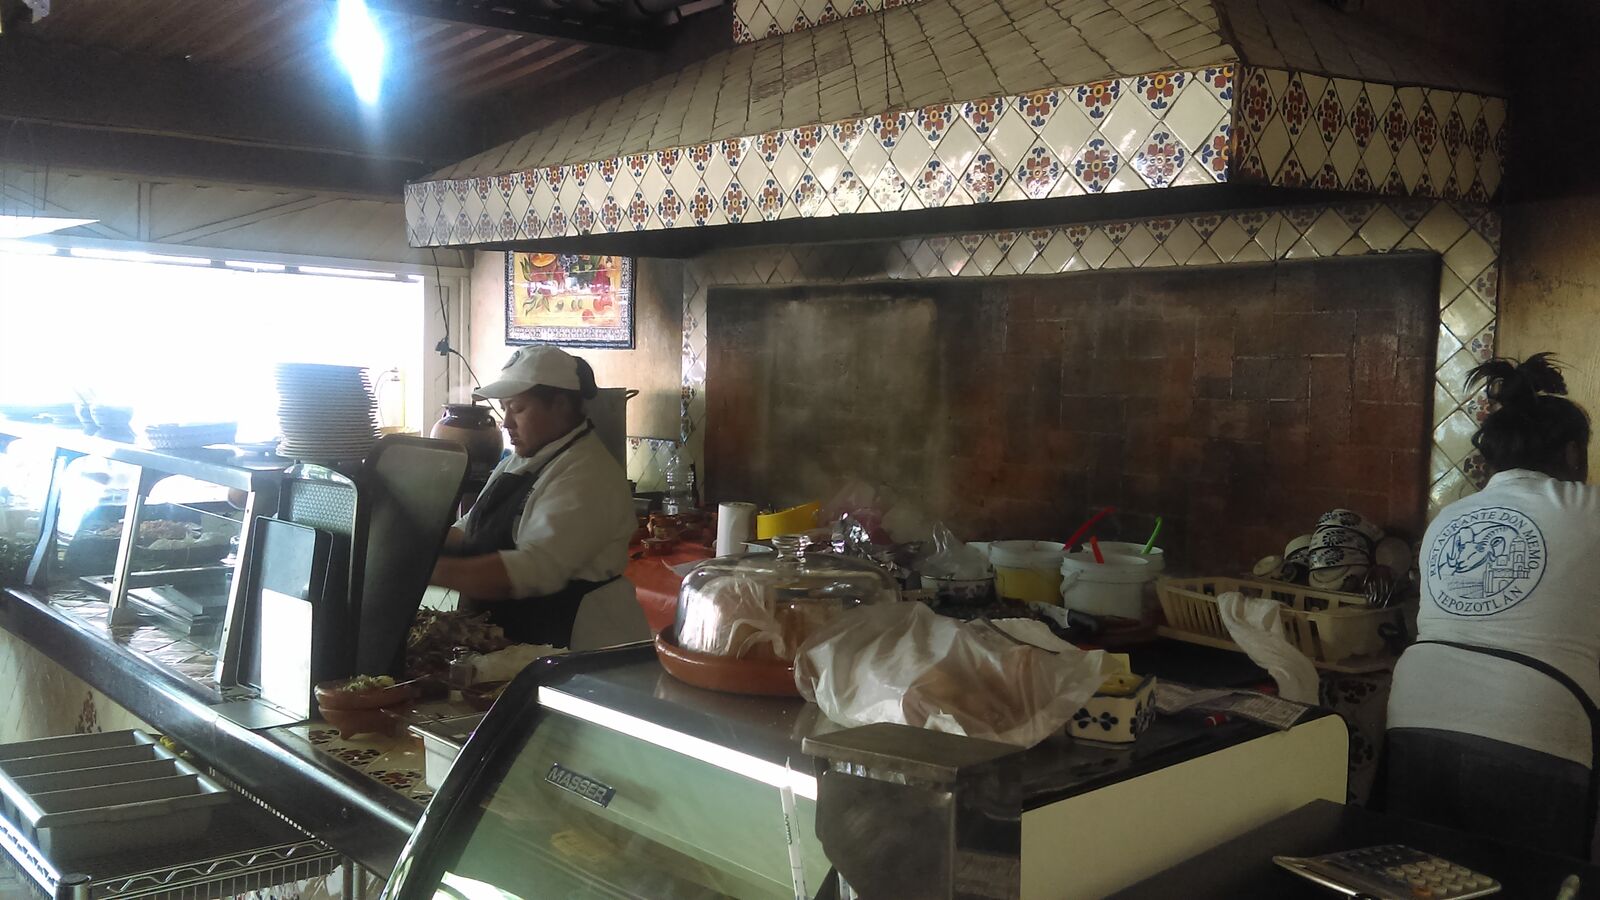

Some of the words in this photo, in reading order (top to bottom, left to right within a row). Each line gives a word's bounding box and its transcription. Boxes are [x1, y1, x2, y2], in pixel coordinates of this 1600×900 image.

[1499, 512, 1527, 530] DON
[1522, 529, 1541, 570] MEMO
[547, 766, 608, 803] MASSER
